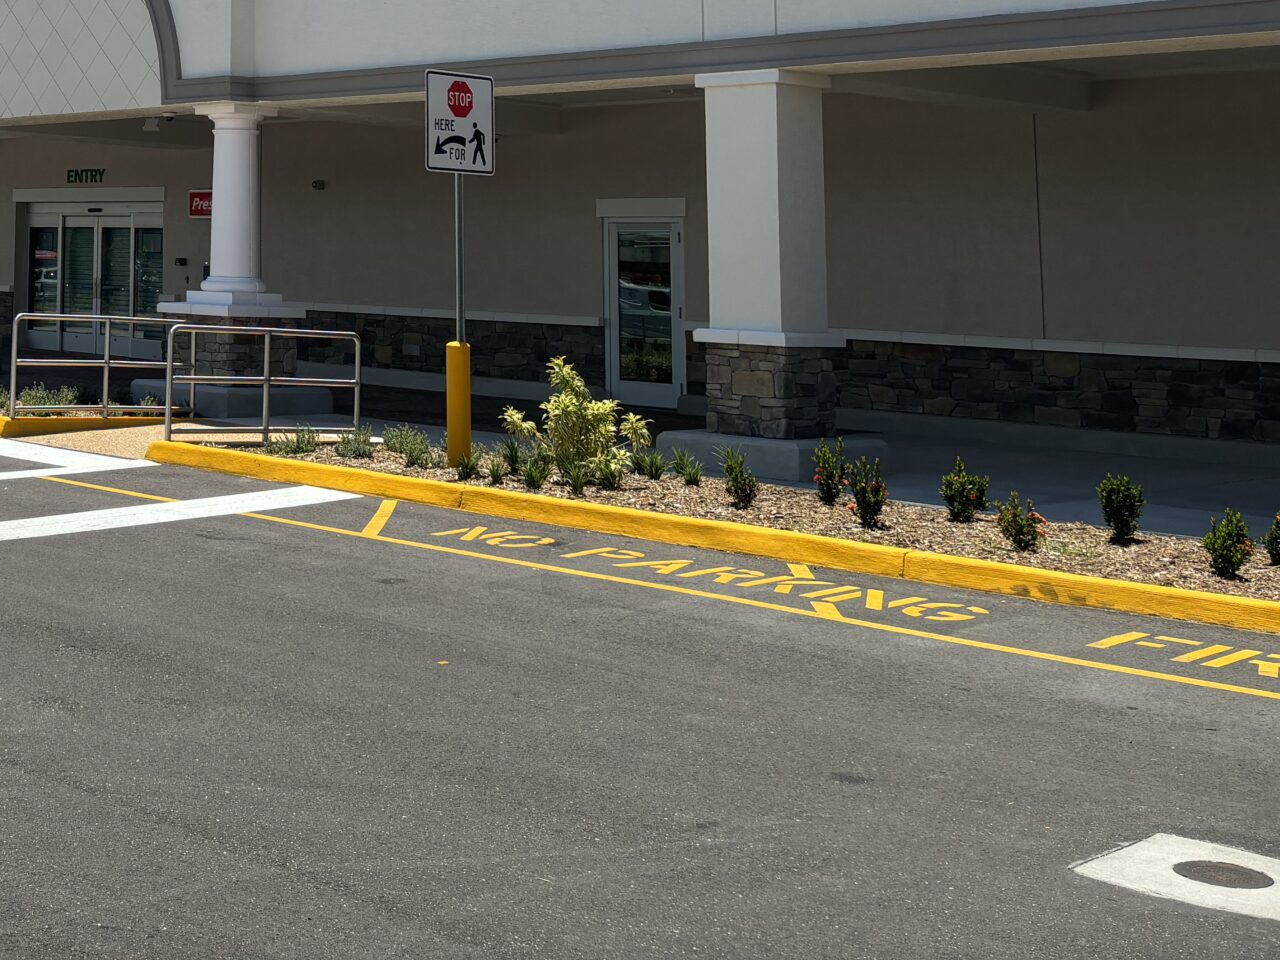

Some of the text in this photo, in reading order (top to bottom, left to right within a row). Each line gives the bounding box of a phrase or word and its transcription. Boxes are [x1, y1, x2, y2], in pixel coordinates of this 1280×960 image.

[448, 91, 472, 107] STOP
[434, 117, 456, 132] HERE
[449, 147, 466, 161] FOR
[66, 167, 106, 184] ENTRY
[431, 526, 556, 549] NO
[560, 546, 990, 622] PARKING
